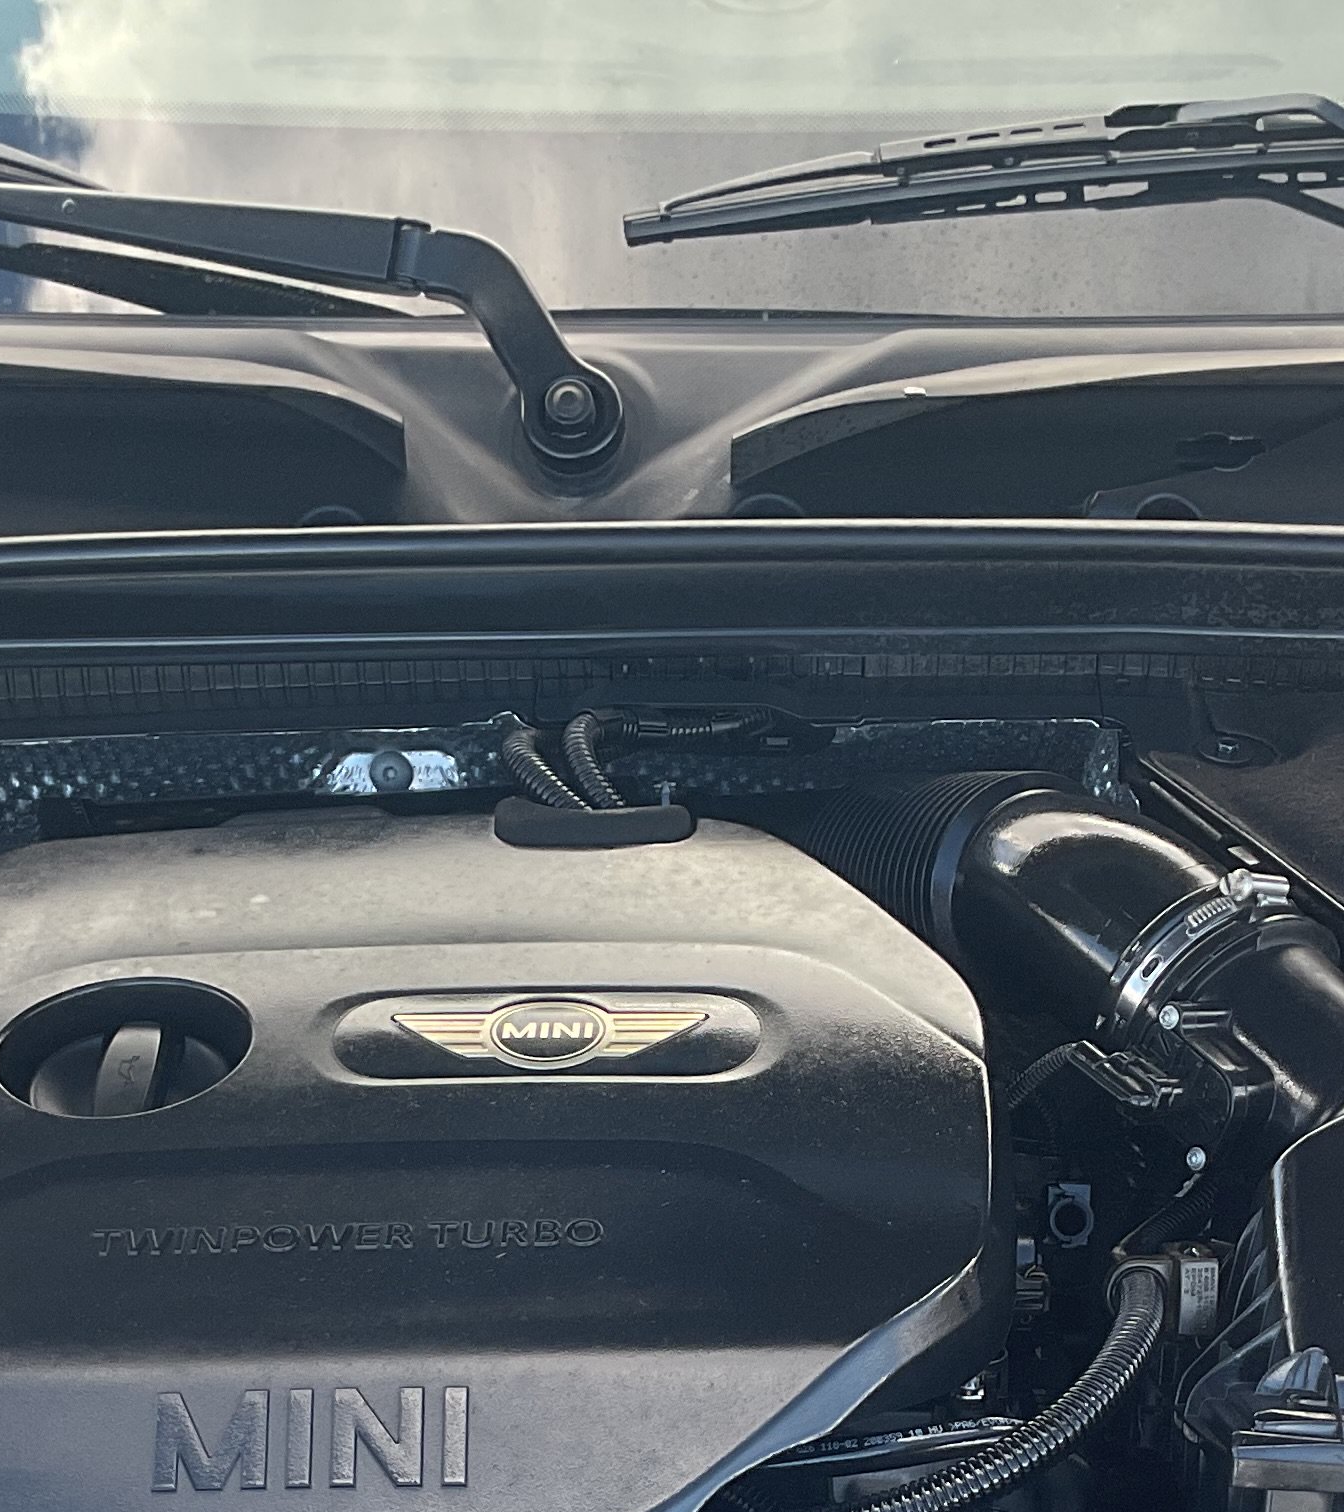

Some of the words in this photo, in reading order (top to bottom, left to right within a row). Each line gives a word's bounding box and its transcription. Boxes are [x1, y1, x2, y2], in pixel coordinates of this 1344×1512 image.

[501, 1022, 594, 1039] MINI
[92, 1222, 415, 1257] TWINPOWER
[428, 1218, 605, 1249] TURBO
[152, 1386, 469, 1491] MINI
